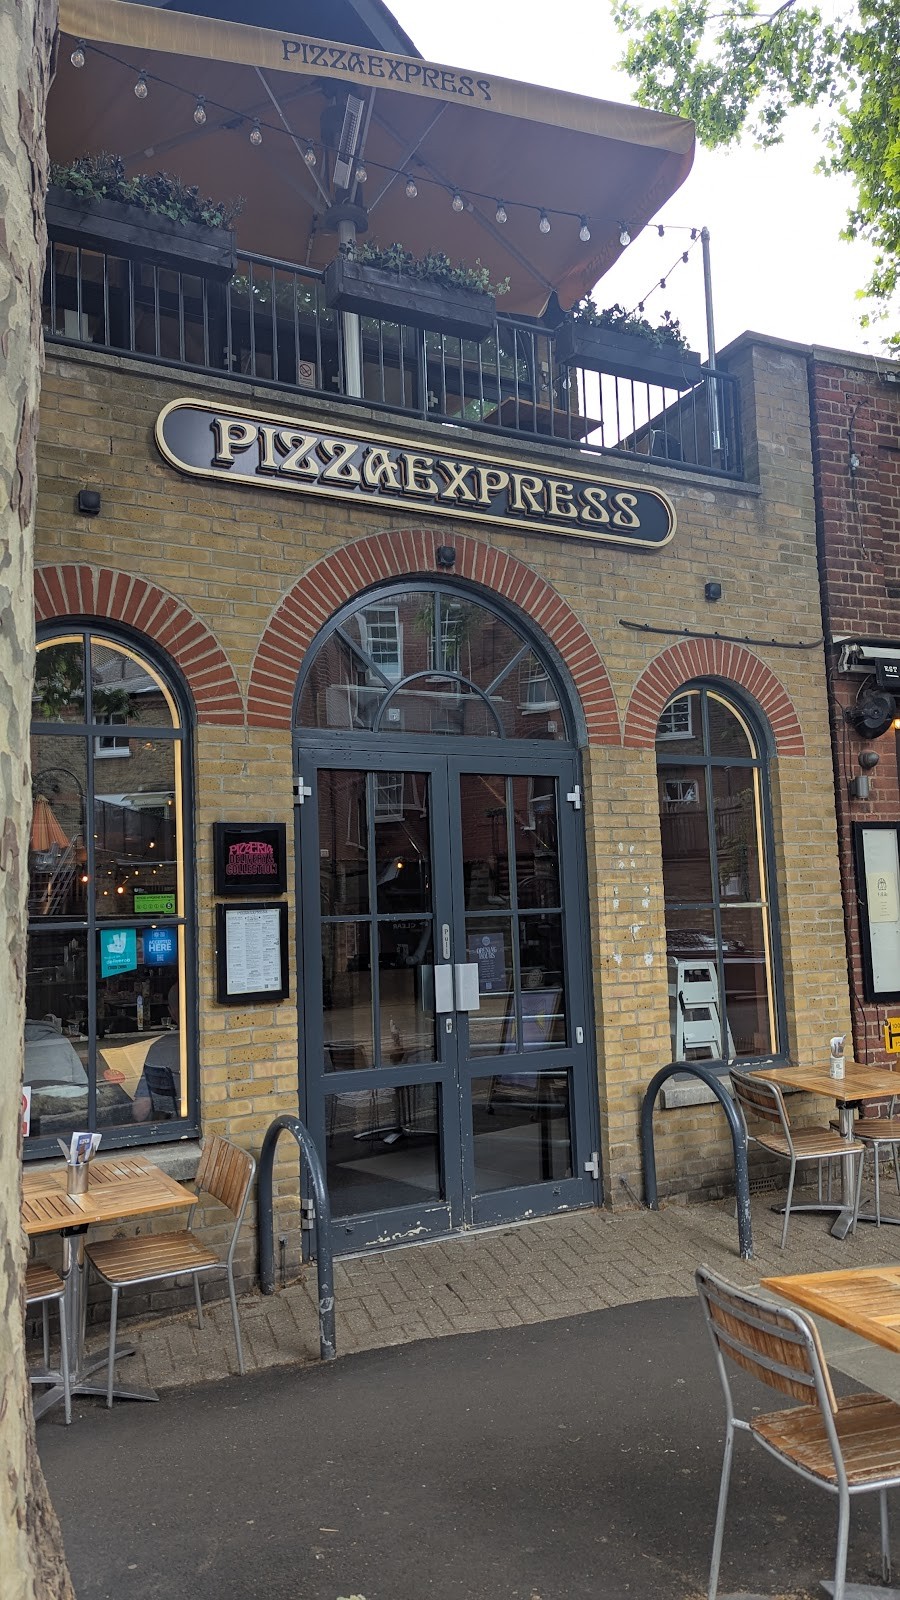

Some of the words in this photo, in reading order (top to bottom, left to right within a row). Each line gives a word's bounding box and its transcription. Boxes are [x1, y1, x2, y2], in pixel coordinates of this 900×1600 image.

[212, 417, 642, 530] PIZZAEXPRESS
[229, 842, 274, 855] PIZZERIA
[226, 863, 277, 875] COLLECTION
[148, 944, 172, 952] HERE
